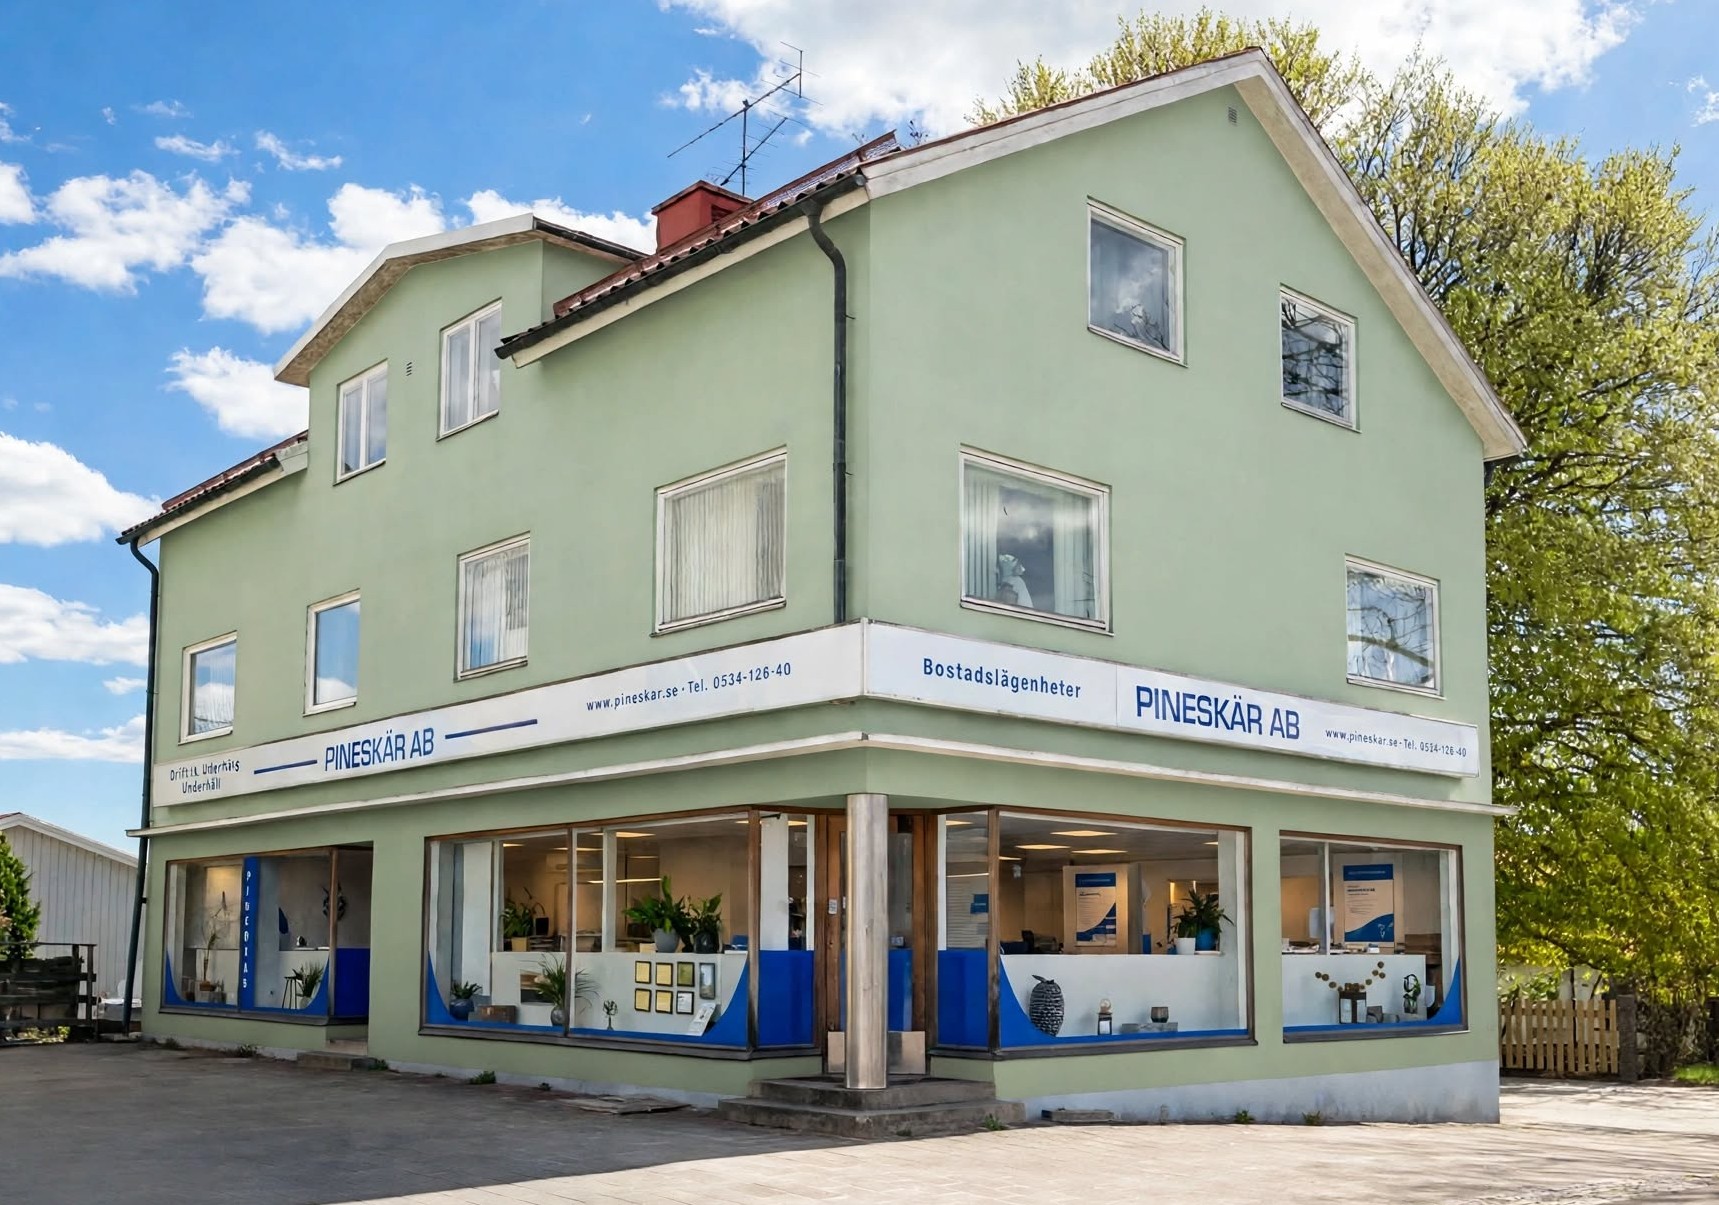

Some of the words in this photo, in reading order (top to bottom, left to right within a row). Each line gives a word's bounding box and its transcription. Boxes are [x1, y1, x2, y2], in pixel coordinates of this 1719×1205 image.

[586, 686, 679, 711] www.pineskar.se
[687, 679, 708, 694] Tel.
[713, 662, 791, 690] 0534-126-40
[923, 658, 1081, 698] Bostadslägenheter
[1136, 686, 1263, 736] PINESKÄR
[1269, 707, 1300, 740] AB
[325, 729, 406, 772] PINESKÄR
[410, 727, 434, 759] AB
[1325, 729, 1398, 748] www.pineskar.se
[1403, 738, 1417, 750] Tel.
